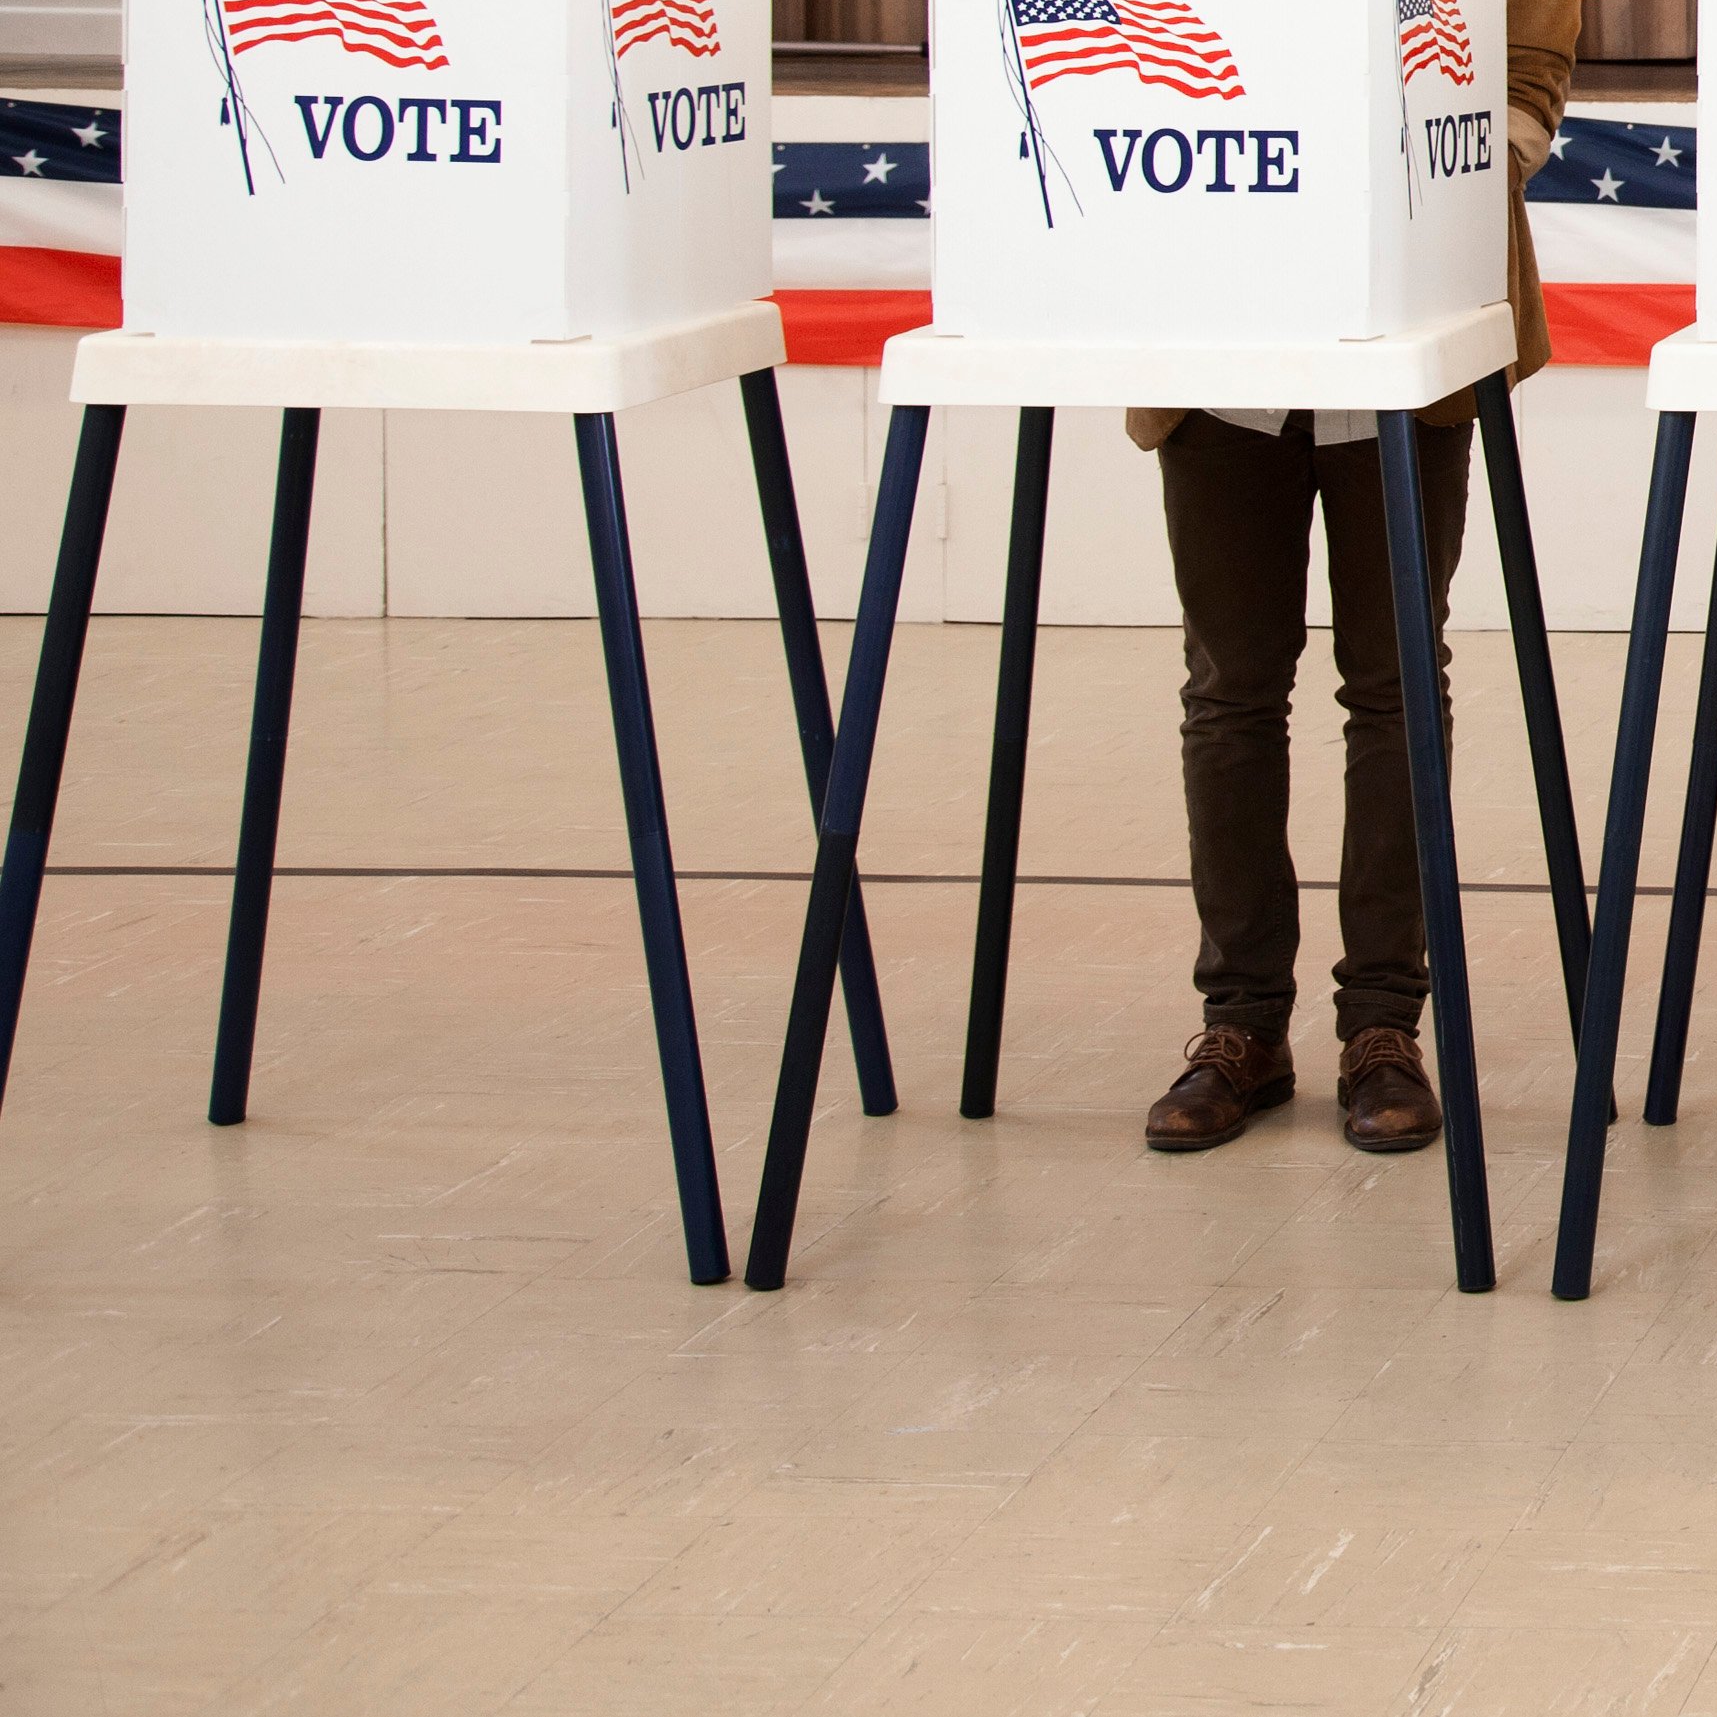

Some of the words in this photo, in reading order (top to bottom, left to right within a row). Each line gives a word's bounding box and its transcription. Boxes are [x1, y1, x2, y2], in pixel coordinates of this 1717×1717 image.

[294, 95, 502, 163] VOTE
[648, 82, 746, 152] VOTE
[1426, 111, 1492, 179] VOTE
[1093, 128, 1300, 193] VOTE
